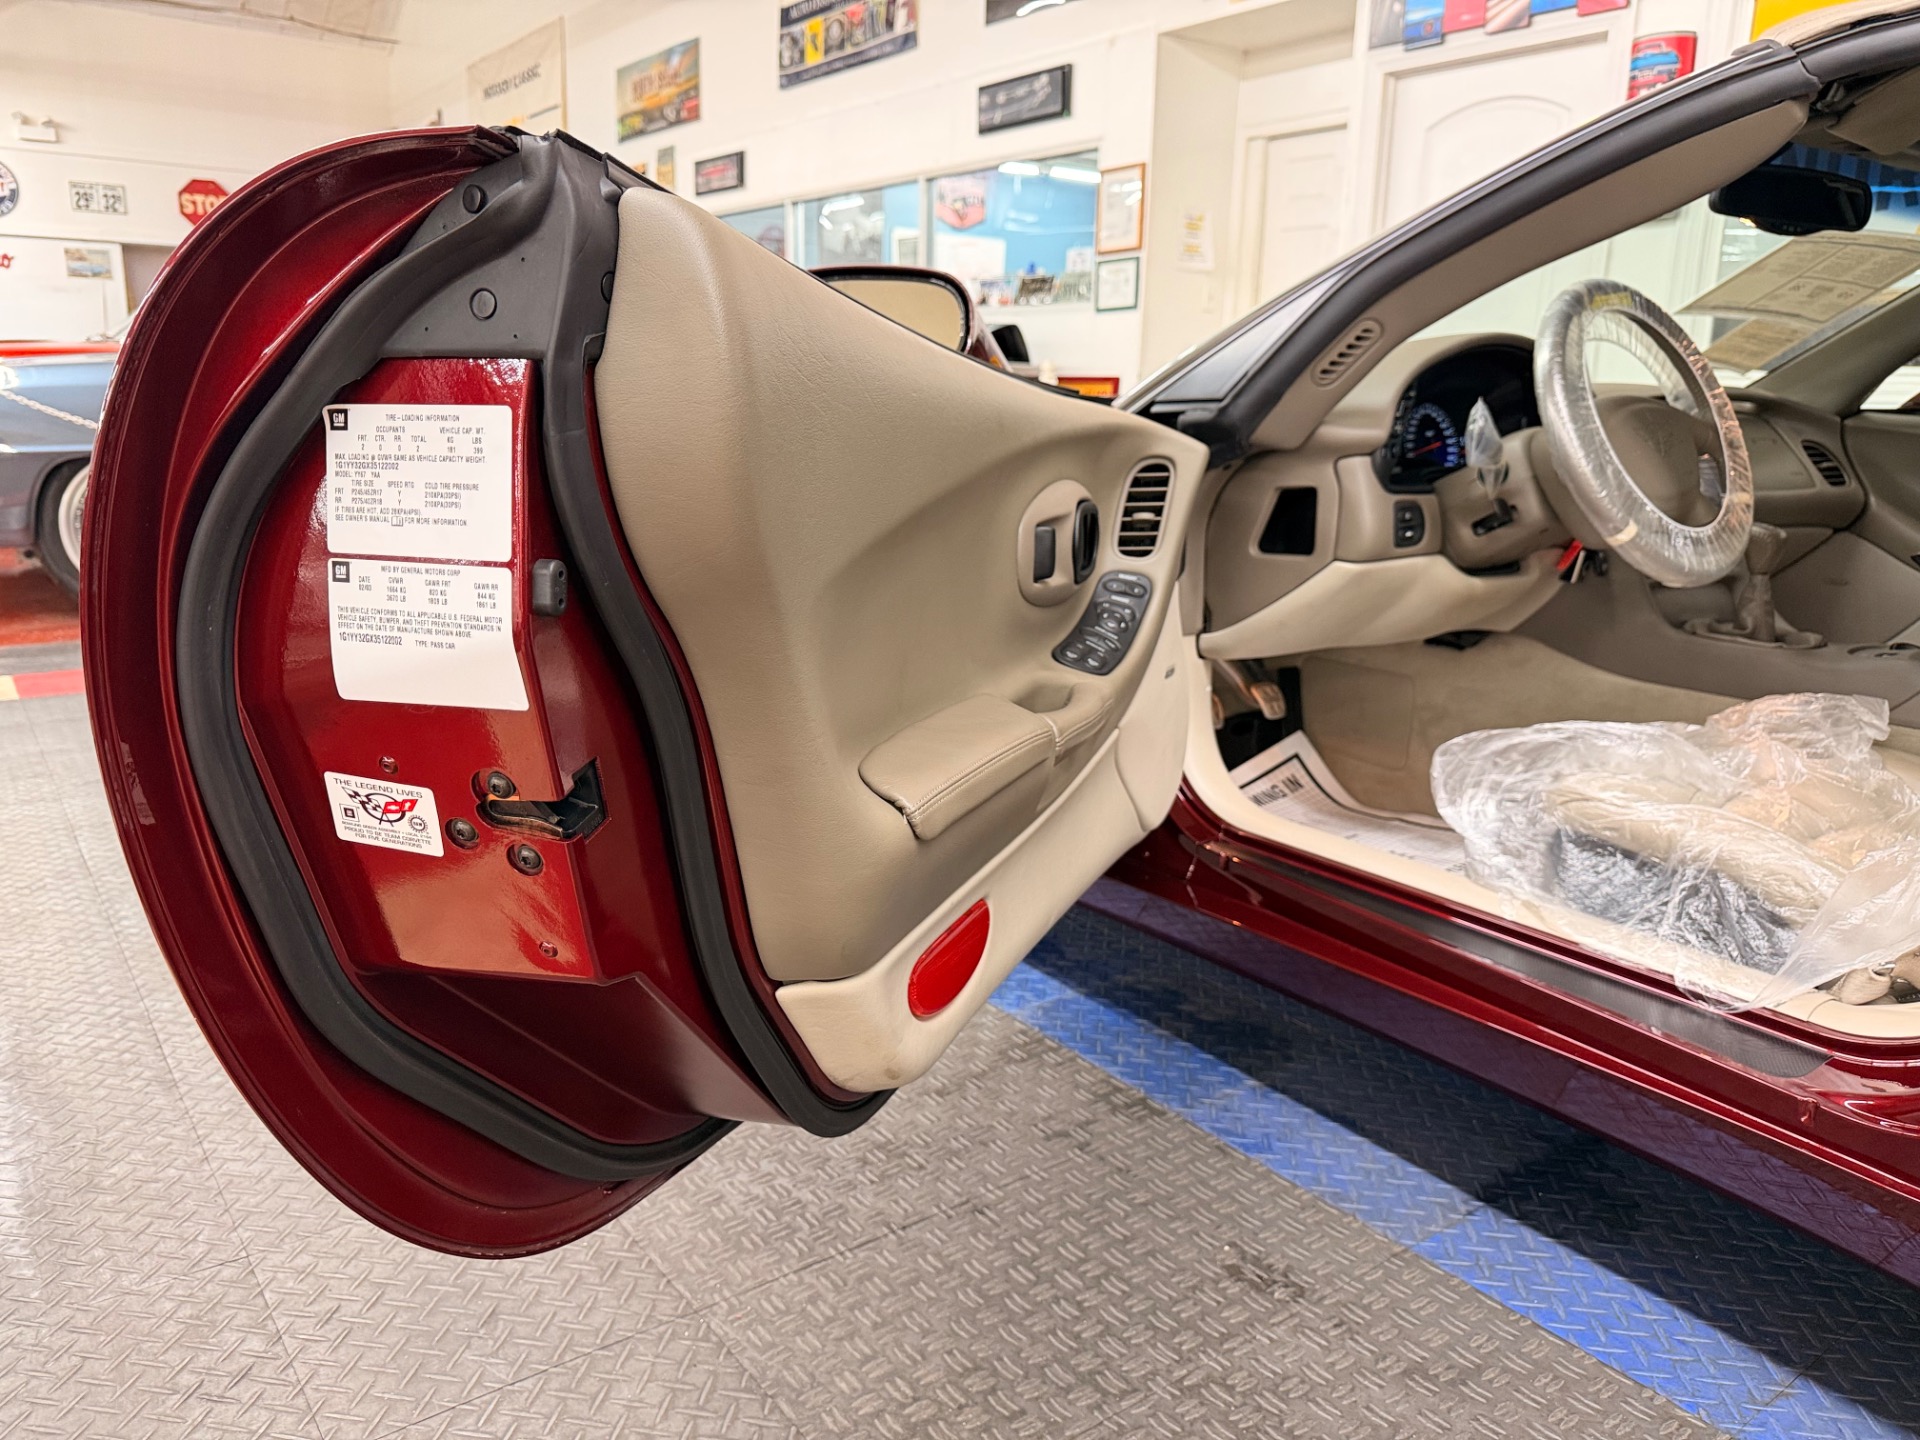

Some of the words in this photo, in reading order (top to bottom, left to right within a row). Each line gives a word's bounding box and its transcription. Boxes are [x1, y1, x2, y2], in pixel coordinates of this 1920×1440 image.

[333, 412, 345, 423] GM
[425, 414, 460, 422] INFORMATION
[335, 564, 347, 574] GM
[401, 566, 423, 575] GENERAL
[425, 579, 440, 587] GAWR
[350, 606, 369, 614] VEHICLE
[370, 608, 397, 616] CONFORMS
[407, 610, 416, 618] ALL
[418, 611, 446, 620] APPLICABLE
[460, 614, 482, 623] FEDERAL
[484, 616, 502, 624] MOTOR
[414, 619, 430, 627] THEFT
[431, 621, 462, 629] PREVENTION
[464, 623, 494, 631] STANDARDS
[396, 626, 433, 635] MANUFACTURE
[431, 641, 444, 649] PASS
[333, 778, 352, 786] THE
[354, 781, 393, 793] LEGEND
[396, 788, 423, 798] LIVES
[1282, 773, 1304, 794] IN
[382, 837, 422, 848] GENERATIONS
[402, 835, 431, 845] CORVETTE
